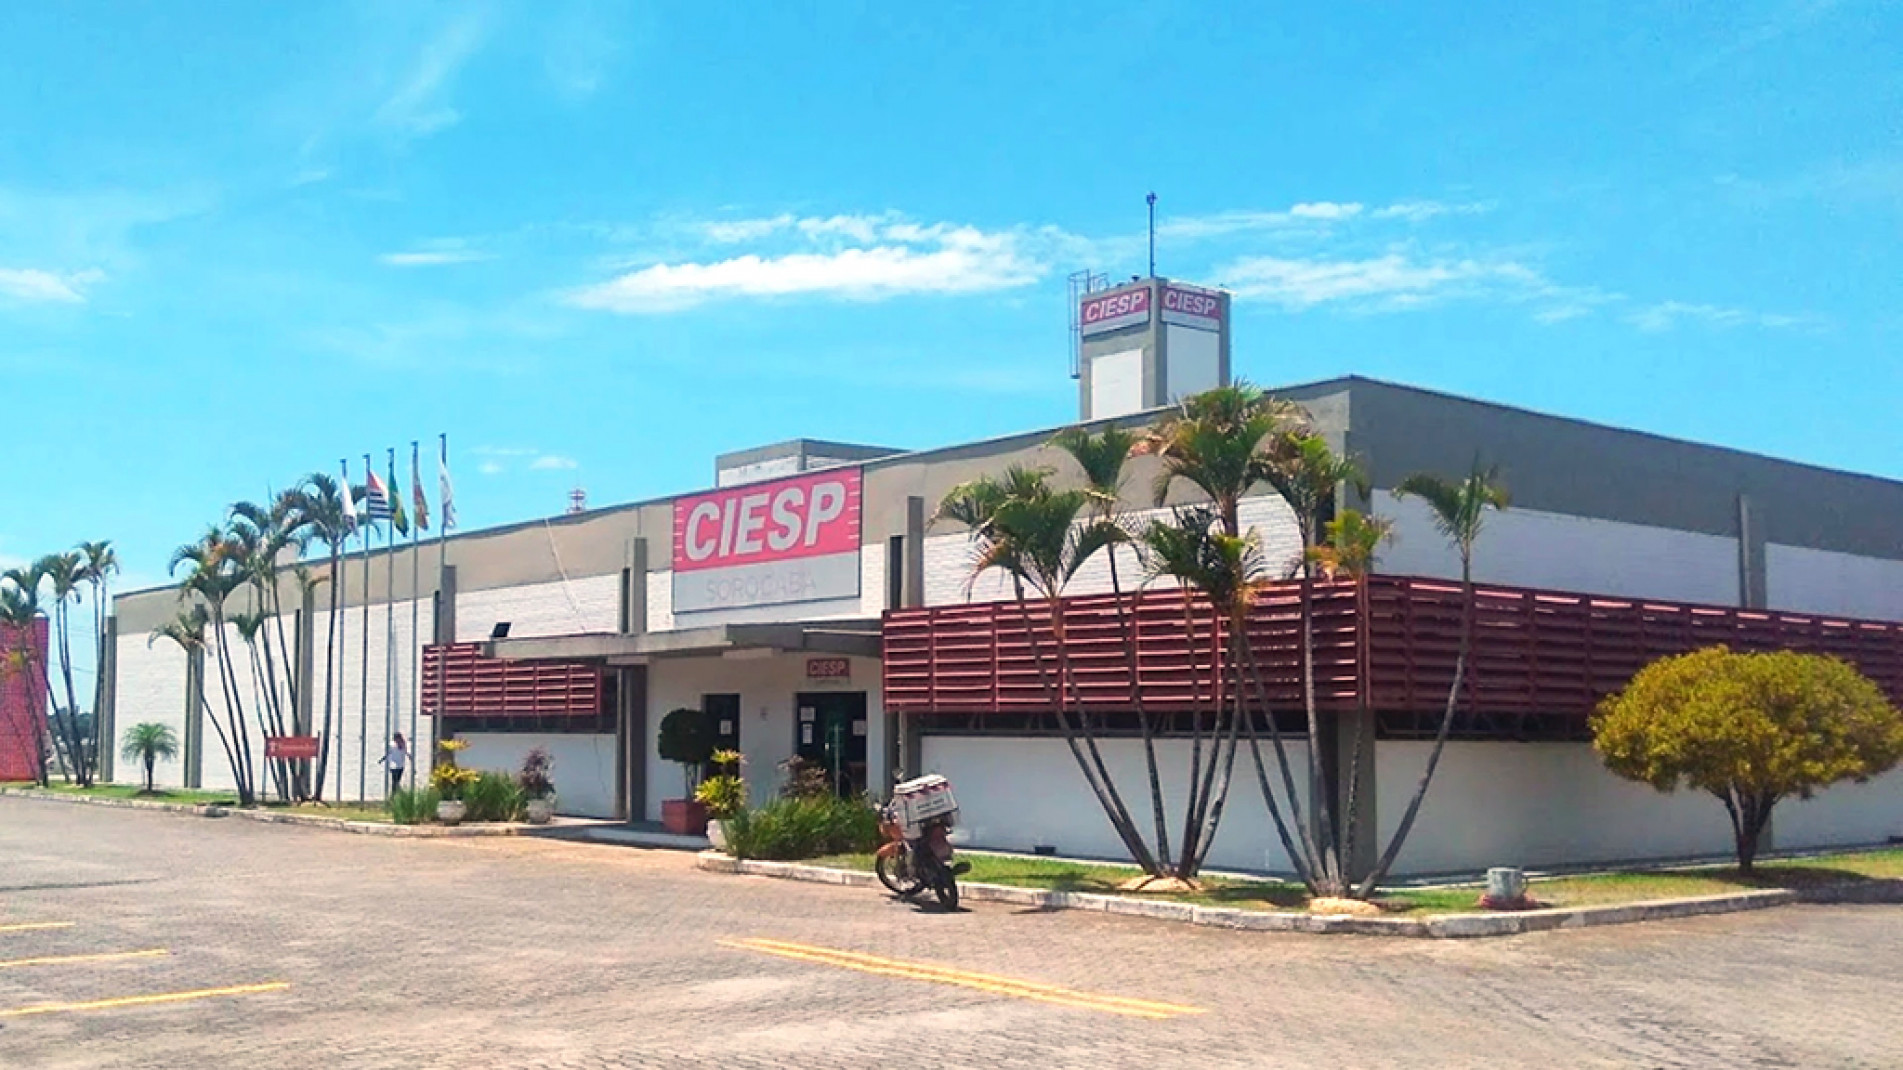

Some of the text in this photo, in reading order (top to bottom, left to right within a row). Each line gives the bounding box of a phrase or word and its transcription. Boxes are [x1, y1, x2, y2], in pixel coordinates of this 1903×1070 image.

[1086, 291, 1144, 321] CIESP
[1165, 289, 1216, 315] CIESP
[685, 481, 846, 561] CIESP
[706, 571, 817, 601] SOROCABA
